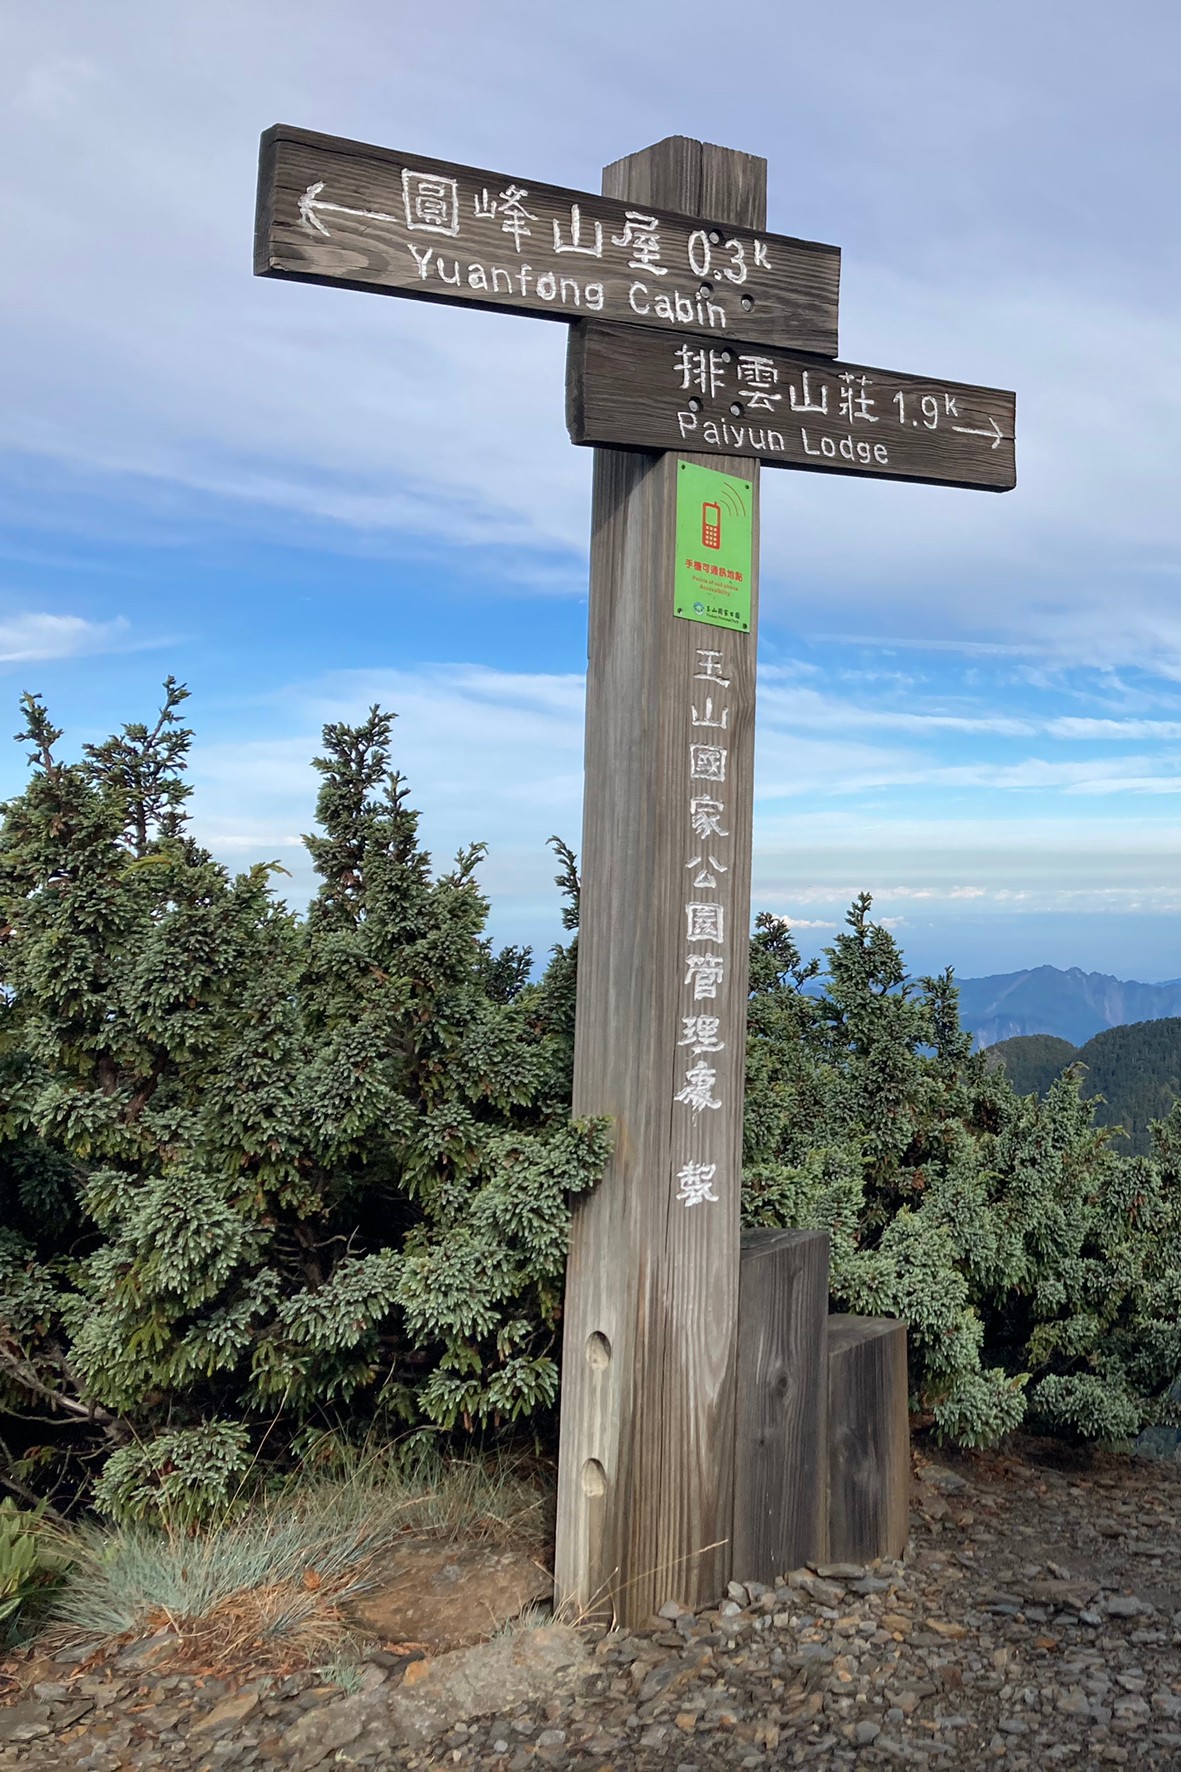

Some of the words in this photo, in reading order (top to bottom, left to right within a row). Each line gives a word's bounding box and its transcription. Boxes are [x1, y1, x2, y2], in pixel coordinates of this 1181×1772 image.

[402, 168, 669, 276] 圓峰山屋
[406, 243, 604, 311] Yuanfong
[628, 280, 727, 328] Cabin
[673, 343, 880, 424] 排雲山莊
[677, 411, 784, 452] Paiyun
[802, 427, 889, 465] Lodge
